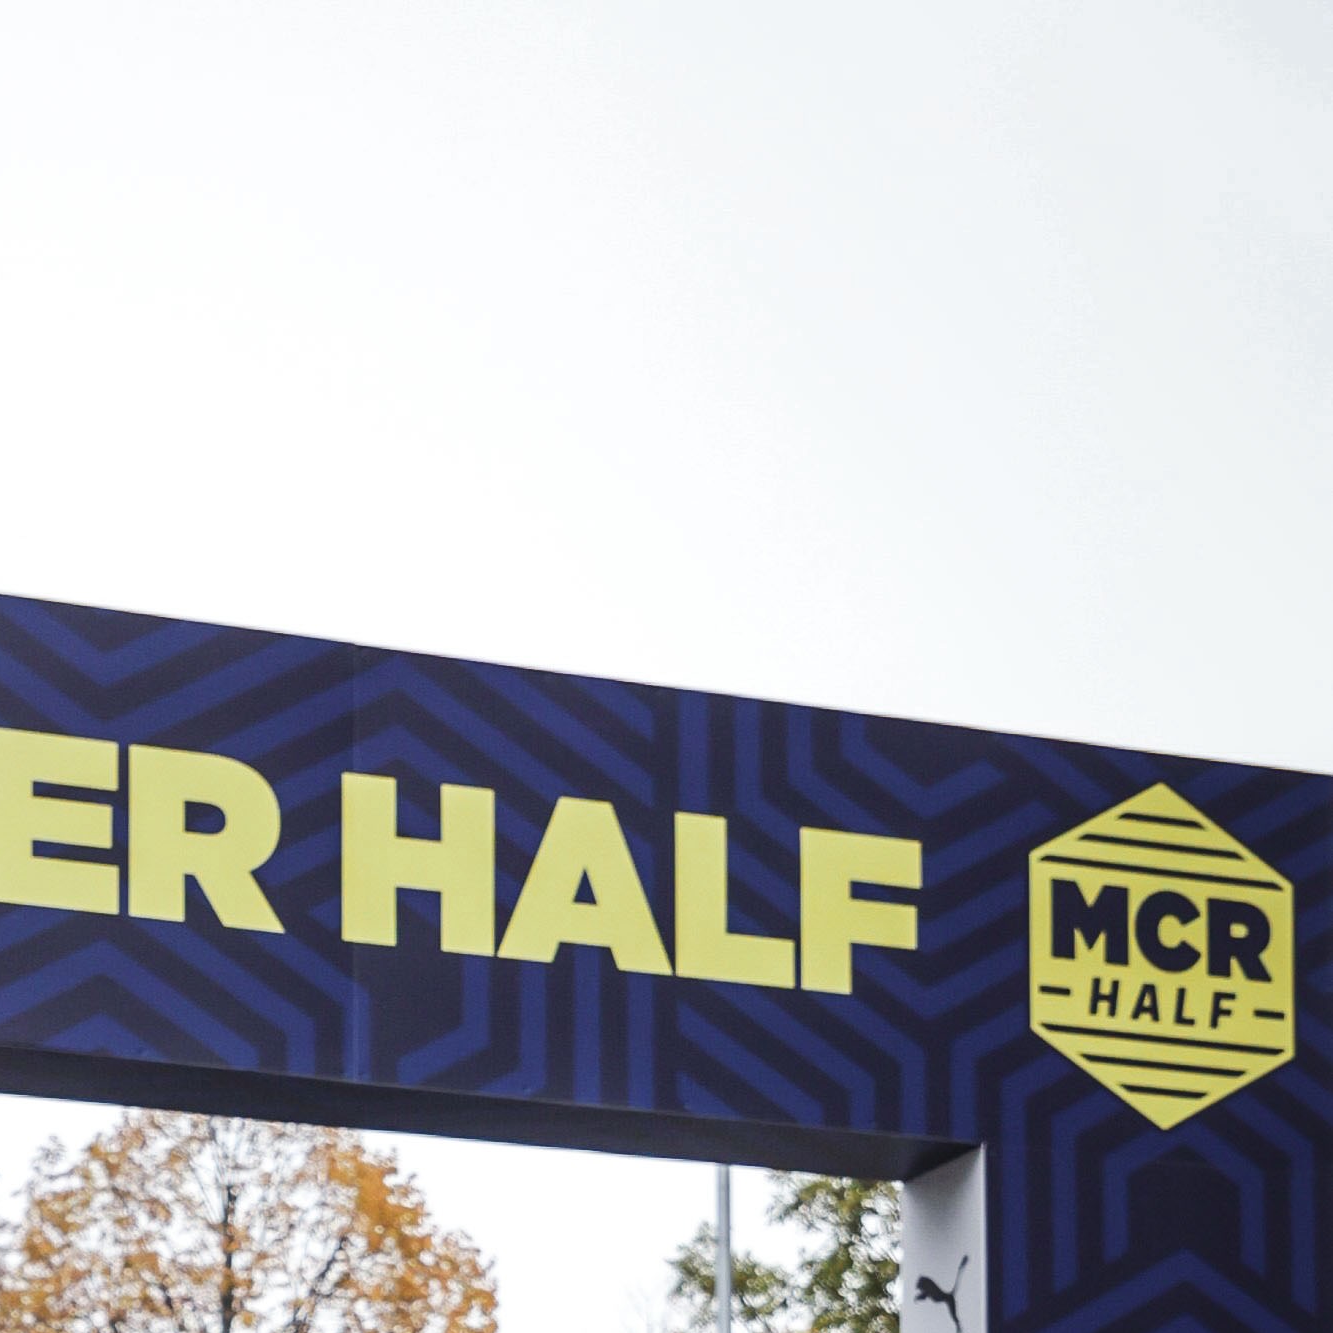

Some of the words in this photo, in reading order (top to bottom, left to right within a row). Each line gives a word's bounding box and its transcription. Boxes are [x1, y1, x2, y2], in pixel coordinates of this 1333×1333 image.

[341, 771, 922, 995] HALF
[1051, 878, 1272, 983] MCR
[1089, 976, 1237, 1030] HALF
